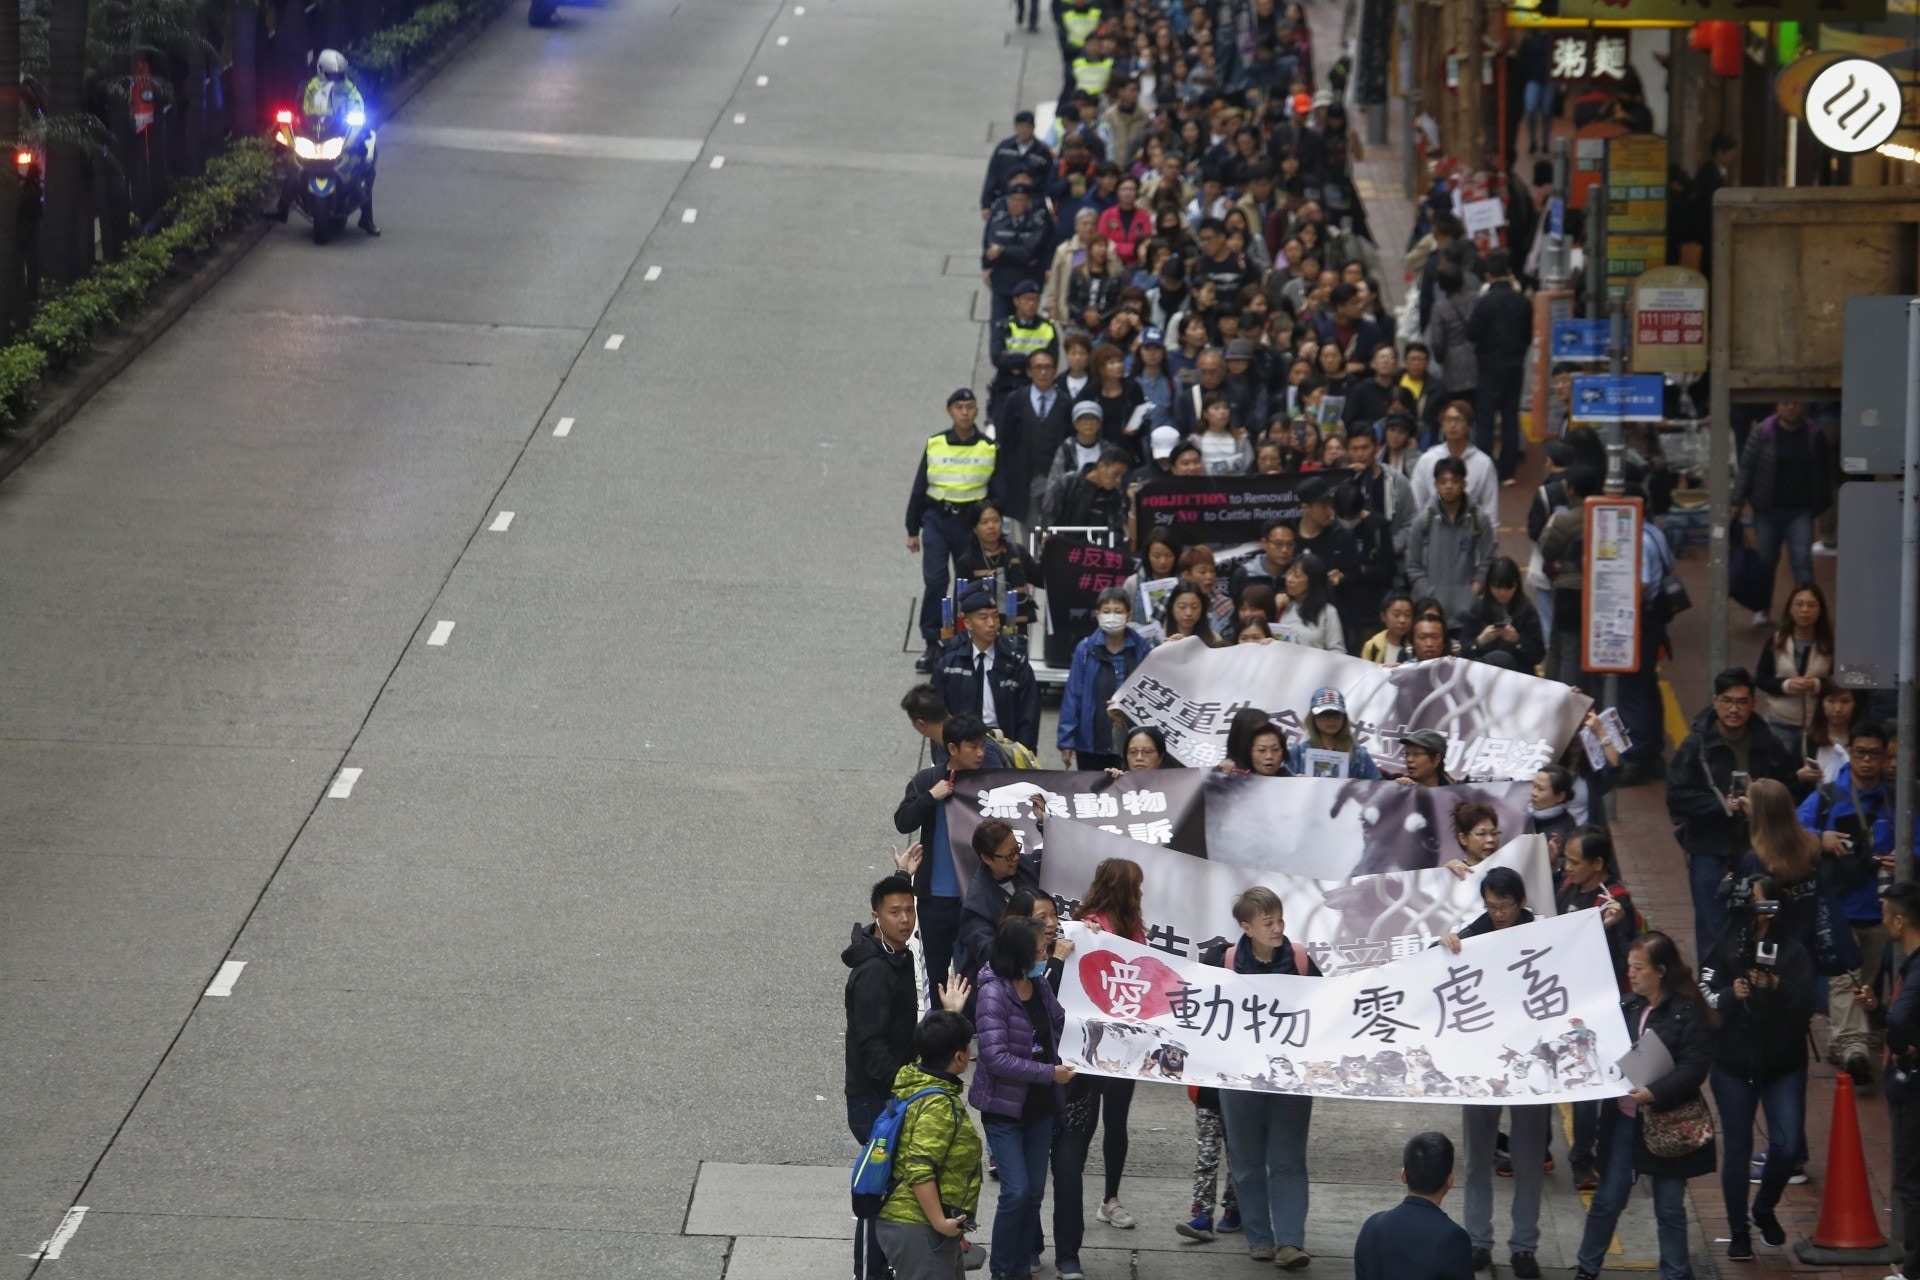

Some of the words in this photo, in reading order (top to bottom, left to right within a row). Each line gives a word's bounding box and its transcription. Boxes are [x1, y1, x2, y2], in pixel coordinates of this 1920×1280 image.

[1550, 36, 1627, 80] 粥麵
[1640, 312, 1659, 325] 111
[1229, 494, 1243, 504] to
[1243, 490, 1293, 503] Removal
[1154, 511, 1175, 526] Say
[1203, 511, 1217, 521] to
[1218, 508, 1252, 521] Cattle
[1351, 946, 1569, 1044] 零虐畜
